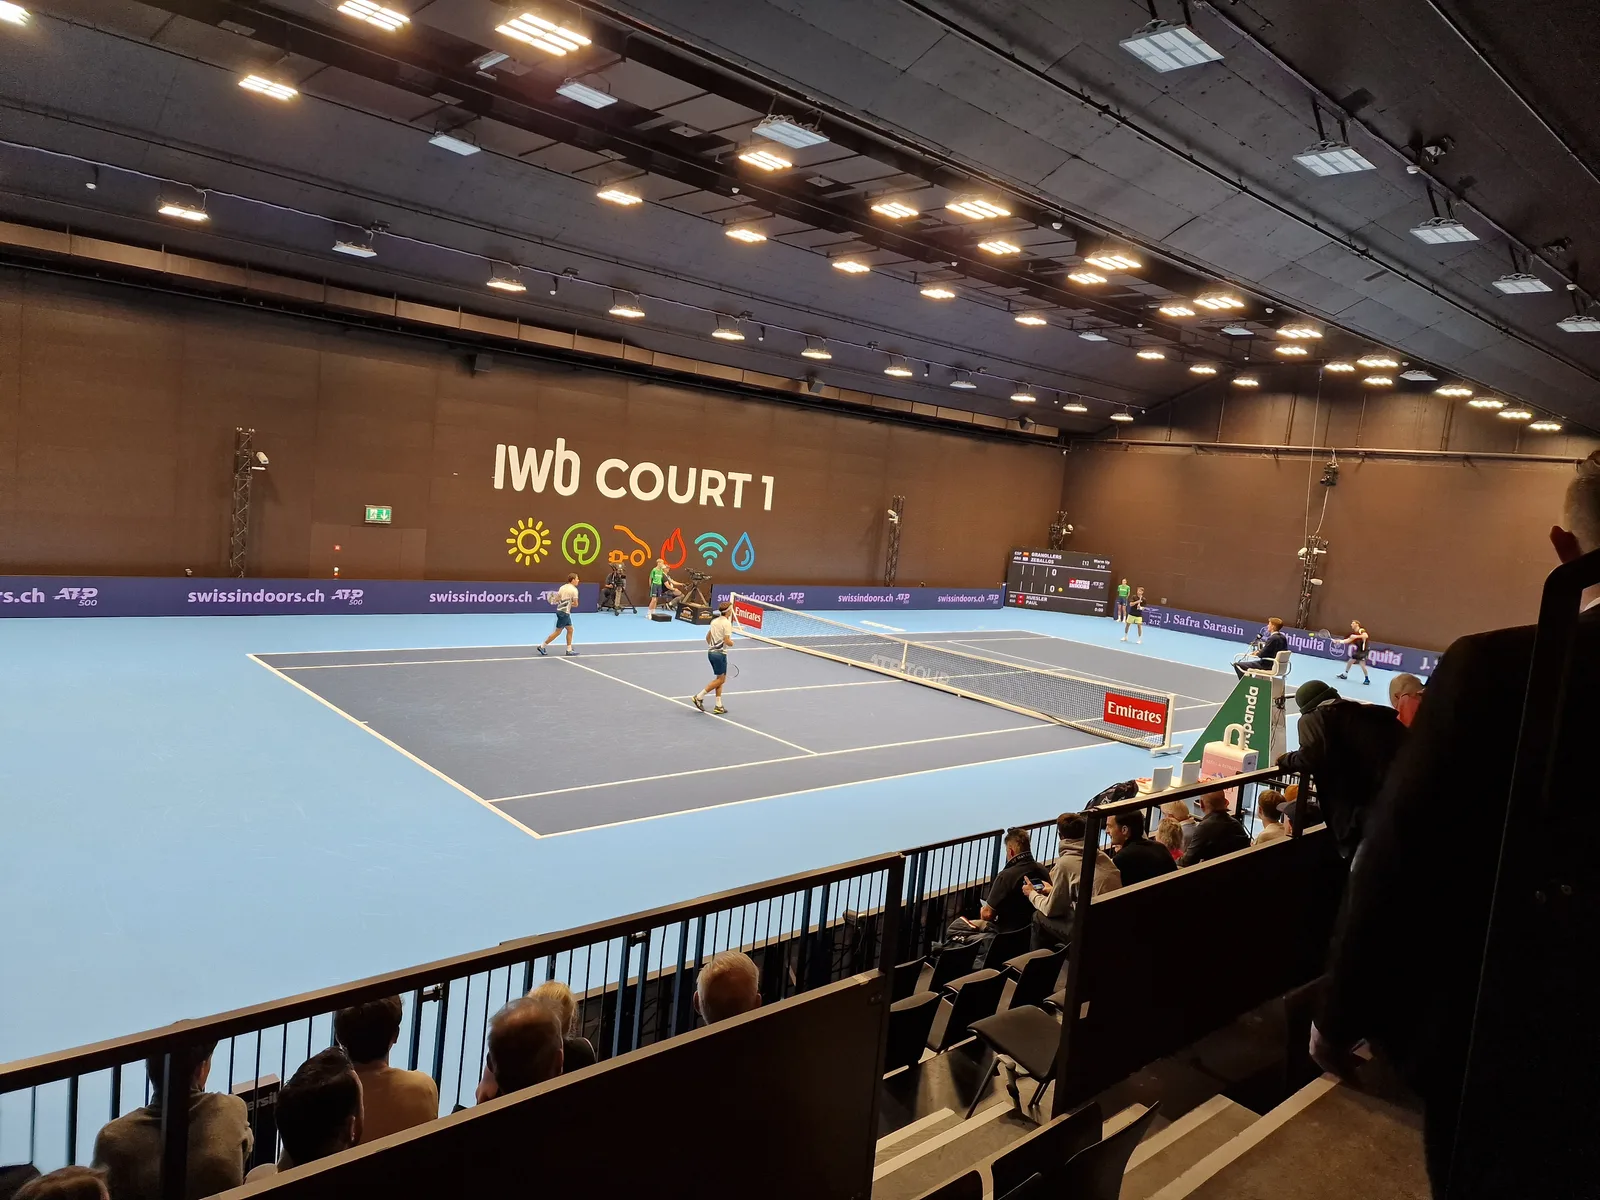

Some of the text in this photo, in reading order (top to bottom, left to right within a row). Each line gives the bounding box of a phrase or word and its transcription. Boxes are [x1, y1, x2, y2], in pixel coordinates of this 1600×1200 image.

[596, 458, 752, 508] COURT
[761, 475, 774, 511] 1
[1030, 557, 1054, 565] ZEBALLOS
[1031, 552, 1062, 560] GRANOLLERS
[1051, 568, 1057, 576] 0
[0, 588, 98, 603] s.ch ATP
[187, 588, 364, 603] swissindoors.ch ATP
[788, 592, 804, 600] ATP
[1049, 585, 1055, 593] 0
[429, 590, 532, 603] swissindoors.ch
[838, 593, 910, 603] swissindoors.ch ATP
[937, 594, 985, 603] swissindoors.ch
[735, 606, 761, 623] Emirates
[1164, 613, 1244, 636] J. Safra Sarasin
[1280, 631, 1324, 651] hiquita
[1347, 644, 1402, 666] Cquita
[1420, 657, 1431, 670] J.
[1107, 701, 1162, 724] Emirates
[247, 1091, 278, 1111] ersil
